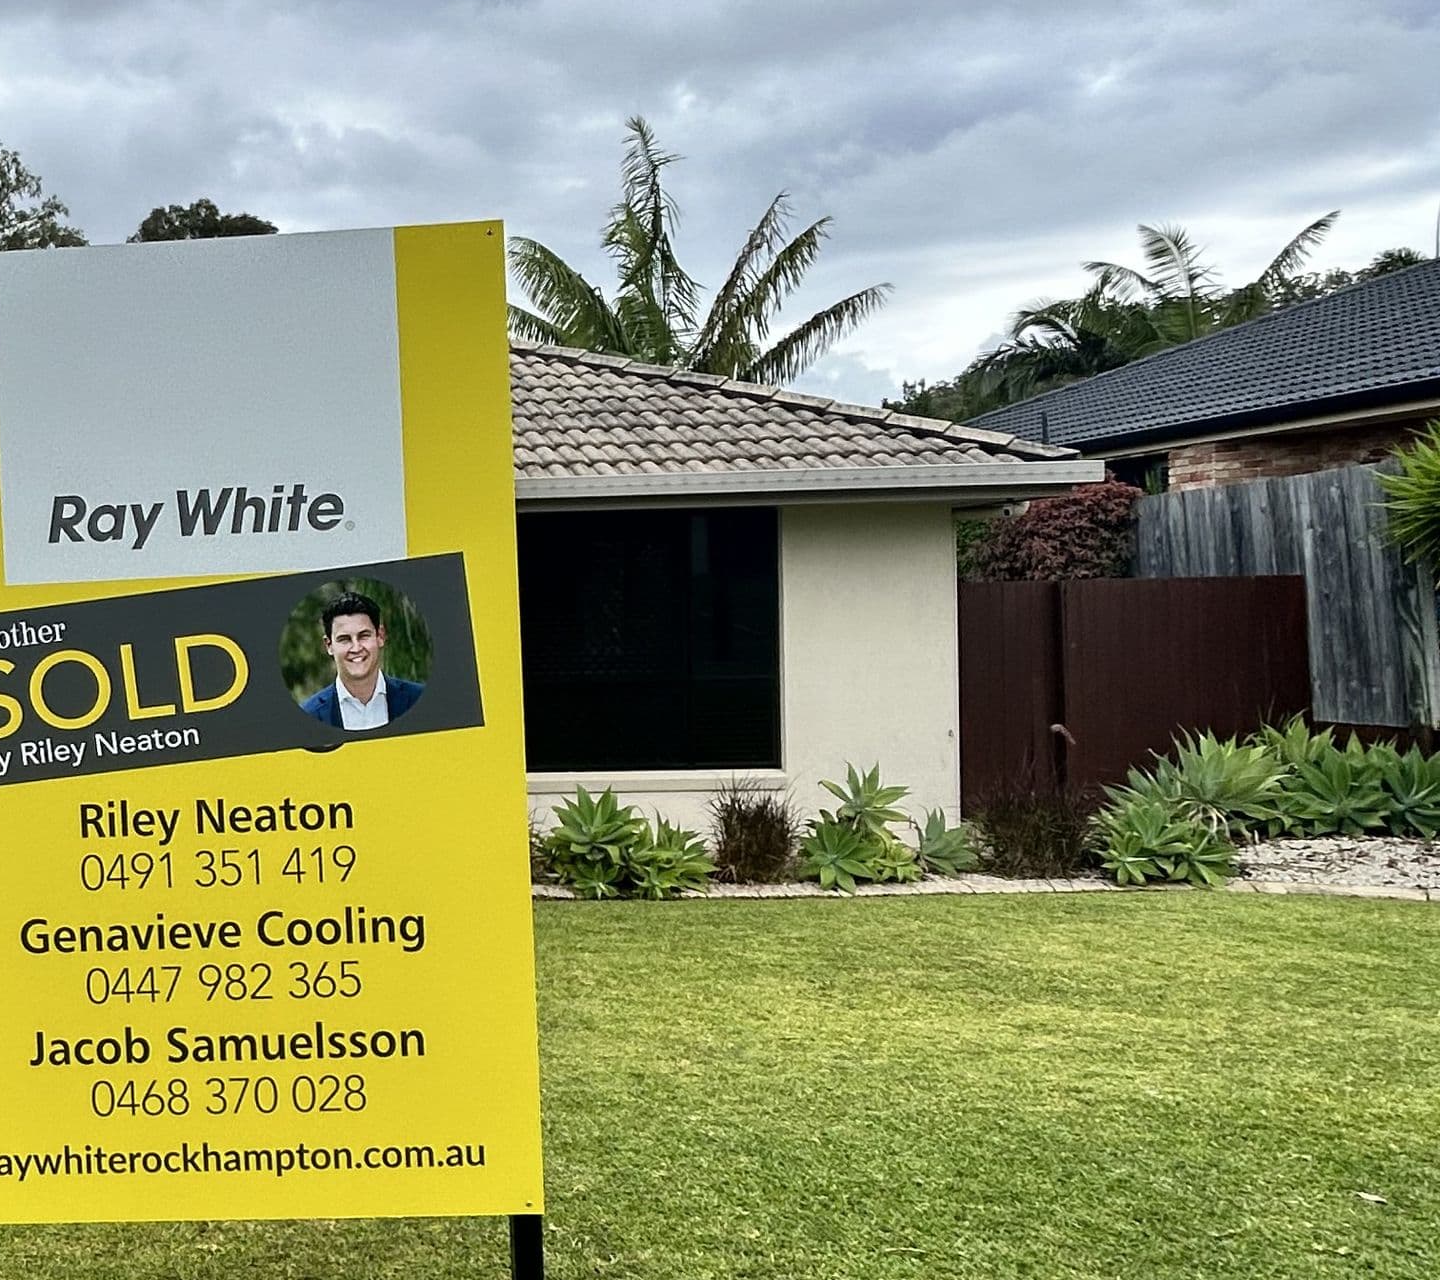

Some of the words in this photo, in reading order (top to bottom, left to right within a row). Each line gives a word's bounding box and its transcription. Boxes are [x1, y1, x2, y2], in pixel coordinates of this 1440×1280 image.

[48, 495, 164, 549] Ray
[176, 484, 344, 536] White
[20, 738, 87, 767] Riley
[94, 725, 200, 756] Neaton
[80, 800, 180, 845] Riley
[195, 798, 354, 834] Neaton
[80, 851, 175, 891] 0491
[194, 848, 263, 888] 351
[281, 845, 357, 883] 419
[20, 913, 241, 954] Genavieve
[257, 906, 426, 951] Cooling
[85, 966, 182, 1005] 0447
[198, 963, 272, 1001] 982
[288, 961, 362, 999] 365
[30, 1026, 150, 1066] Jacob
[167, 1022, 425, 1063] Samuelsson
[90, 1079, 190, 1117] 0468
[205, 1077, 278, 1115] 370
[291, 1074, 367, 1112] 028
